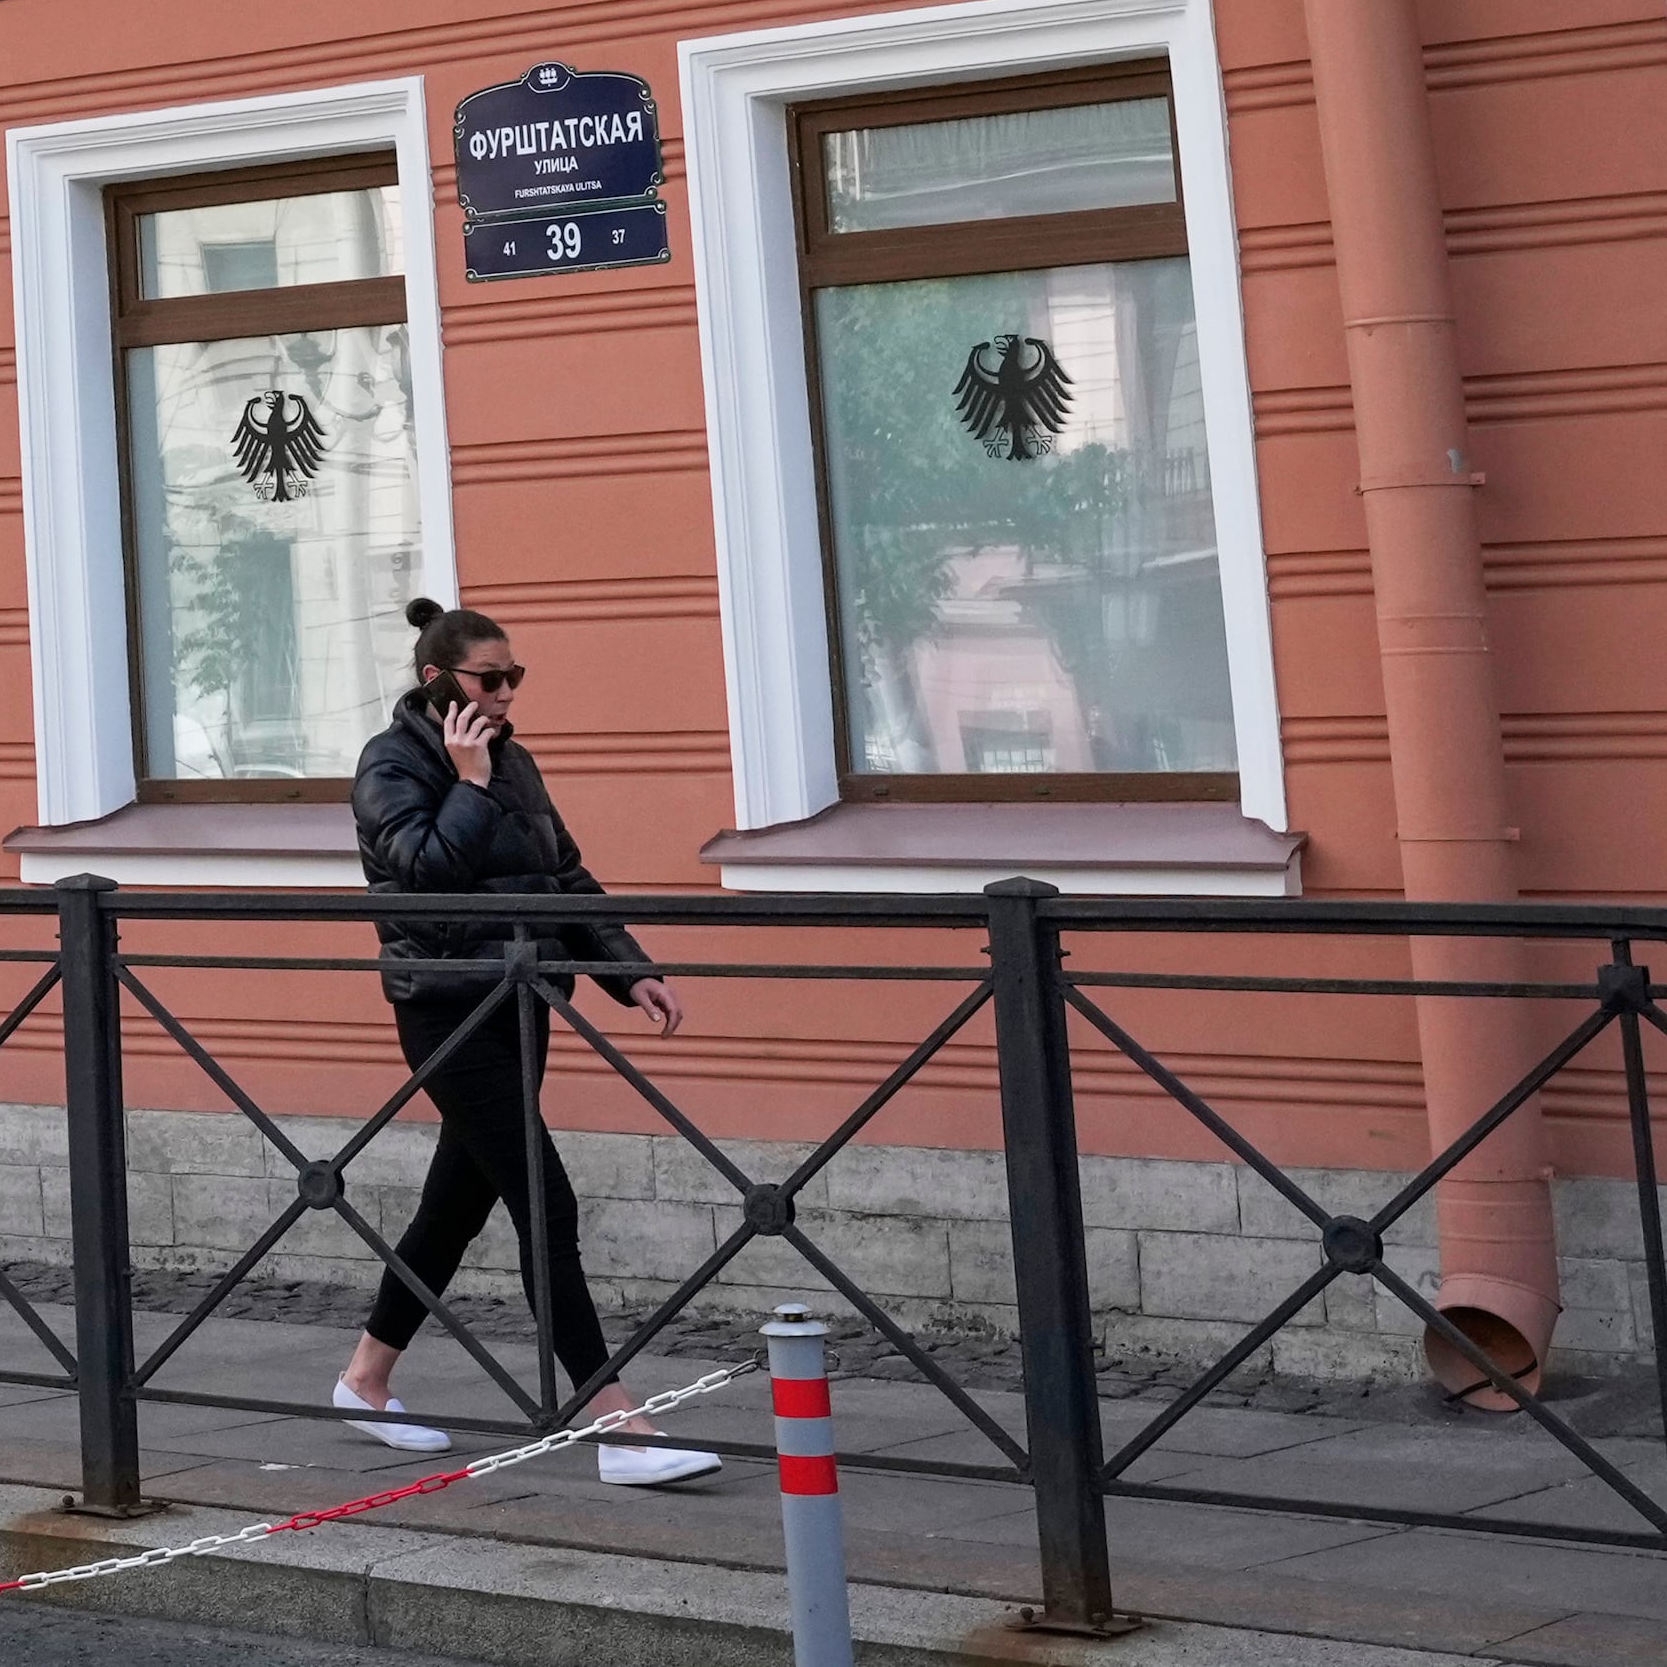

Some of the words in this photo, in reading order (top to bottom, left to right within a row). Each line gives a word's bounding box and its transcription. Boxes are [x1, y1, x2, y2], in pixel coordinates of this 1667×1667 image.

[469, 111, 644, 160] ФУРШТАТСКАЯ
[534, 156, 579, 175] УЛИЦА
[514, 184, 575, 199] FURSHTATSKAYA
[575, 180, 602, 192] ULITSA
[503, 241, 516, 256] 41
[546, 222, 582, 261] 39
[612, 229, 626, 245] 37
